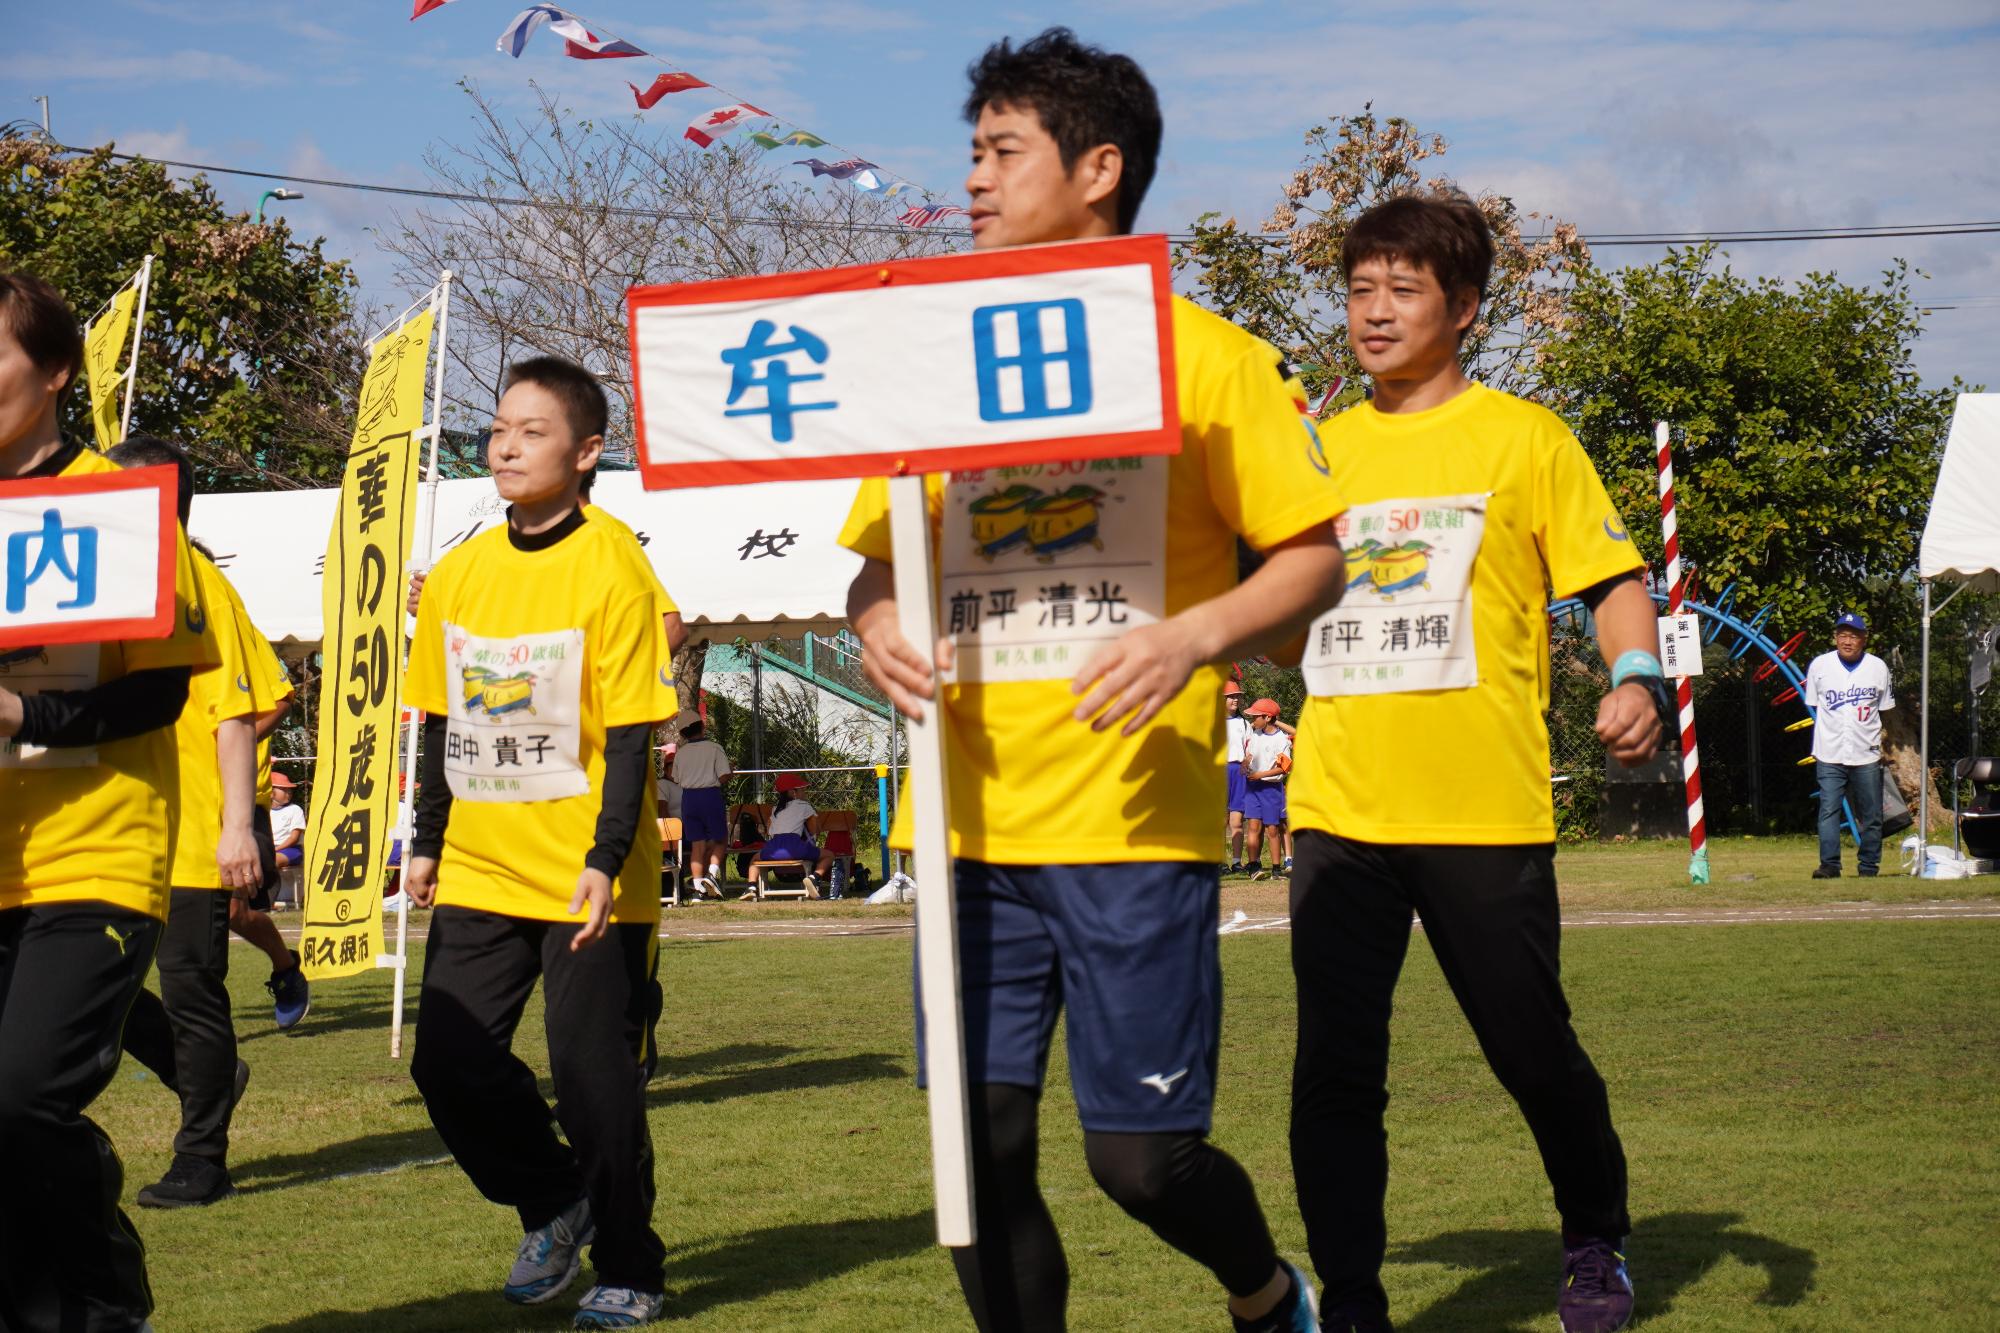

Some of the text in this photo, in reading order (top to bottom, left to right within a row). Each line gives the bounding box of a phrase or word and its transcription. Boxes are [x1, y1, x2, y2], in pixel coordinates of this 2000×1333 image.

[6, 507, 98, 613] 内
[949, 580, 1129, 634] 前平 清光
[1380, 613, 1450, 653] 清輝
[316, 449, 390, 893] 華の50歳組
[1825, 683, 1877, 709] Dodgers
[1857, 706, 1871, 722] 17
[447, 732, 556, 768] 田中 貴子
[304, 931, 370, 968] 阿久根市
